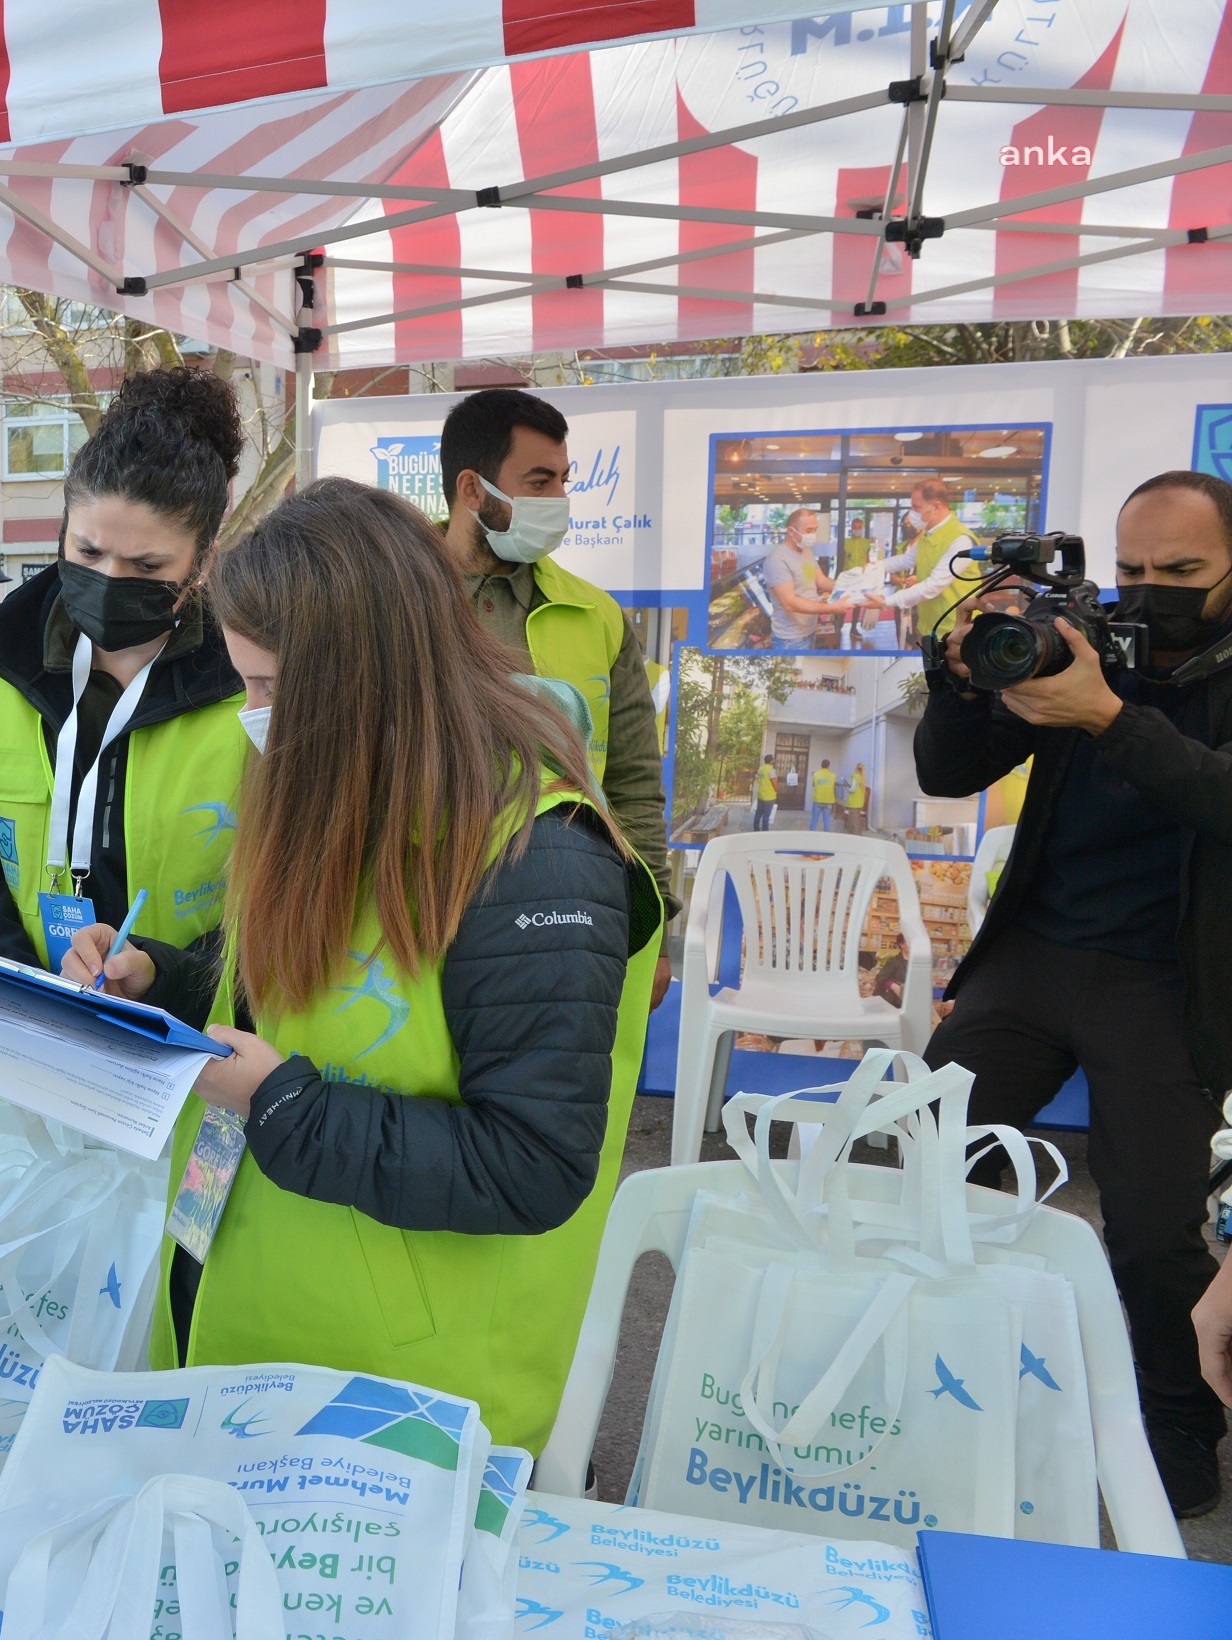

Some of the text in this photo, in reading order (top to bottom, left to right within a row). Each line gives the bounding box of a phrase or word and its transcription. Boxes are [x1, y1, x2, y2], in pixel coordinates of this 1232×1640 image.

[612, 514, 652, 533] Çalık
[574, 533, 624, 549] Başkanı
[62, 905, 82, 914] SAHA
[532, 910, 594, 927] Columbia
[244, 1374, 296, 1383] Belediyesi
[220, 1381, 294, 1397] Beylikdüzü
[63, 1404, 141, 1419] ÇÖZÜM
[62, 1414, 135, 1435] SAHA
[237, 1454, 412, 1489] Belediye Başkanı
[299, 1475, 410, 1506] Mehmet
[590, 1523, 721, 1552] Beylikdüzü
[590, 1534, 679, 1558] Belediyesi
[350, 1554, 397, 1585] bir
[666, 1574, 801, 1610] Beylikdüzü
[667, 1585, 759, 1610] Belediyesi
[354, 1596, 394, 1616] ve
